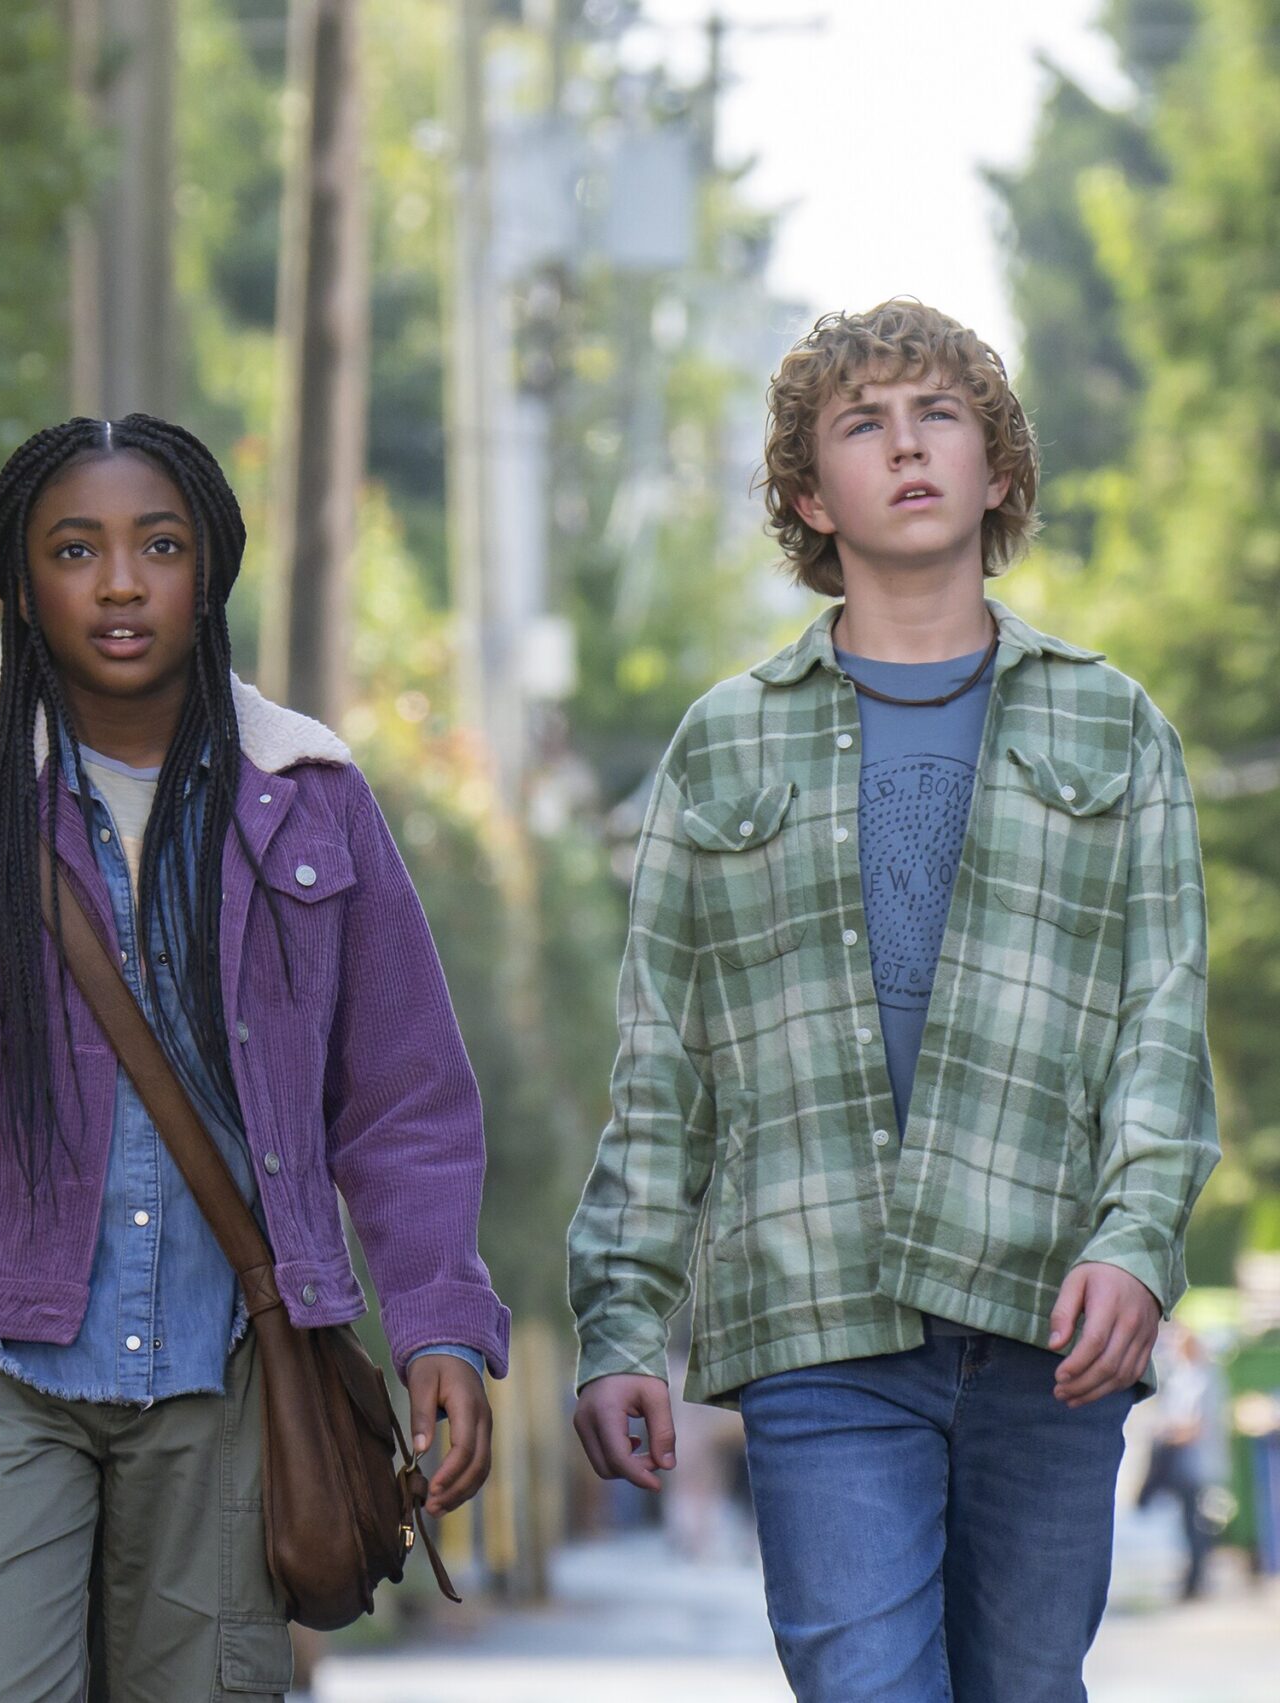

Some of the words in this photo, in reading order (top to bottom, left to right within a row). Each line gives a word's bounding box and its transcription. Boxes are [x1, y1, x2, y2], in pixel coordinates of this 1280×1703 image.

[859, 779, 896, 810] LD
[919, 774, 972, 806] BON
[870, 866, 912, 892] EW
[924, 863, 952, 886] YO
